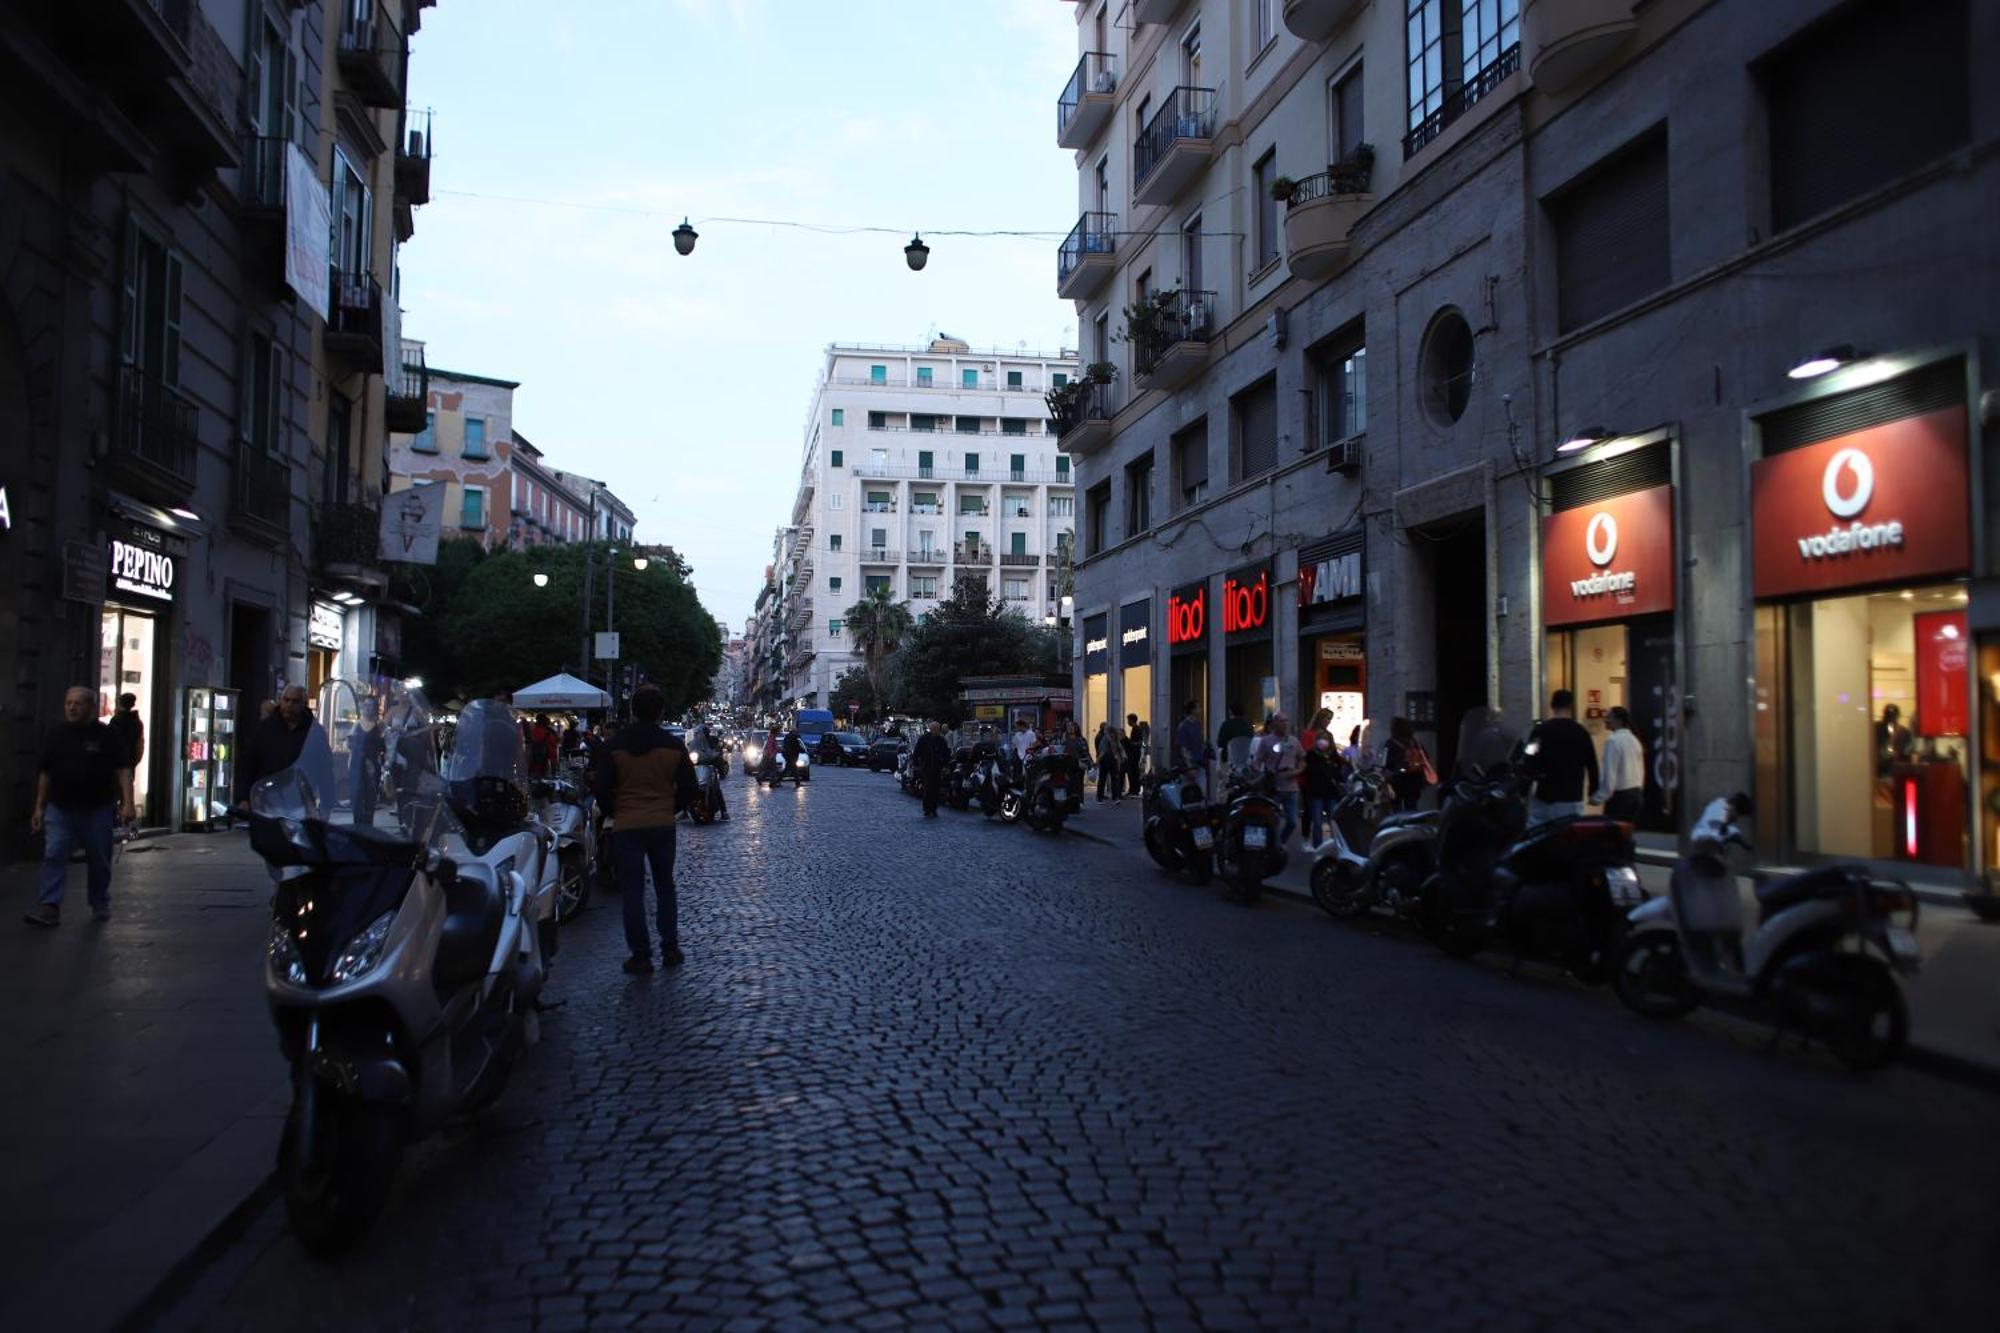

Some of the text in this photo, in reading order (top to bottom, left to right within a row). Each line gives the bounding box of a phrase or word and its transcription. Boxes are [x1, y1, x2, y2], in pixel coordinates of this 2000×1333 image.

[112, 540, 173, 588] PEPINO
[1798, 522, 1903, 558] vodafone
[1223, 574, 1267, 632] iliad
[1571, 570, 1635, 596] vodafone
[1168, 587, 1203, 644] iliad
